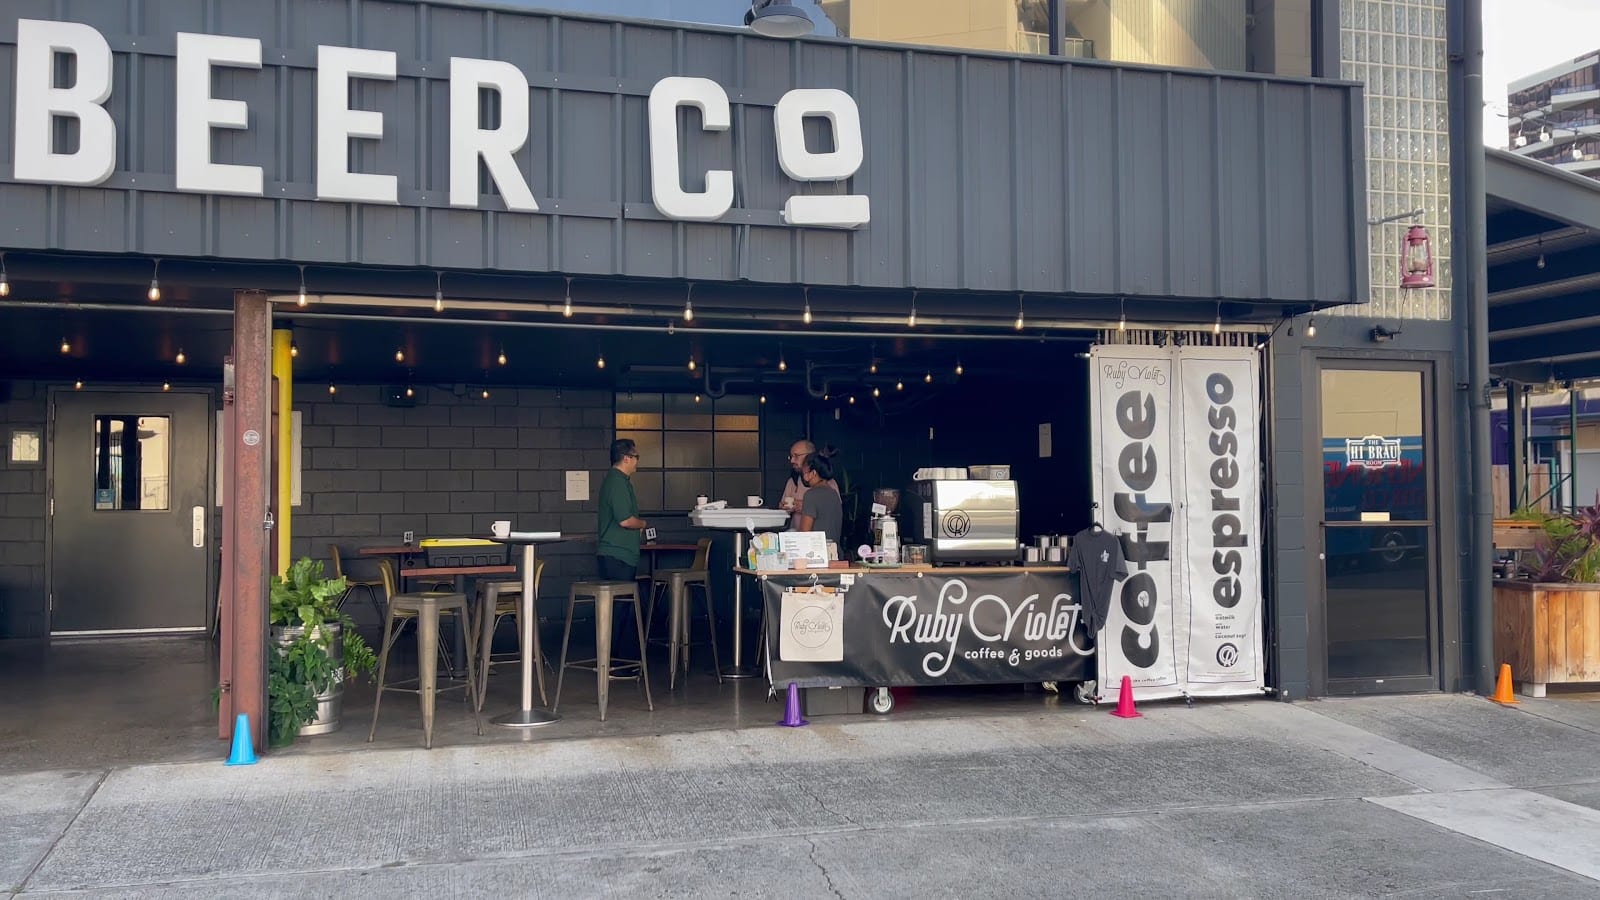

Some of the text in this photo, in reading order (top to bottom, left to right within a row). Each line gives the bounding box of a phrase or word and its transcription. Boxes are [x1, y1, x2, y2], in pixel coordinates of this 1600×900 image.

[14, 18, 539, 212] BEER
[1104, 361, 1166, 389] Ruby Violet
[1206, 372, 1248, 609] espresso
[1351, 445, 1363, 459] HI
[1114, 390, 1172, 669] coffee
[882, 579, 1095, 677] Ruby Violet
[964, 646, 1063, 667] coffee & goods
